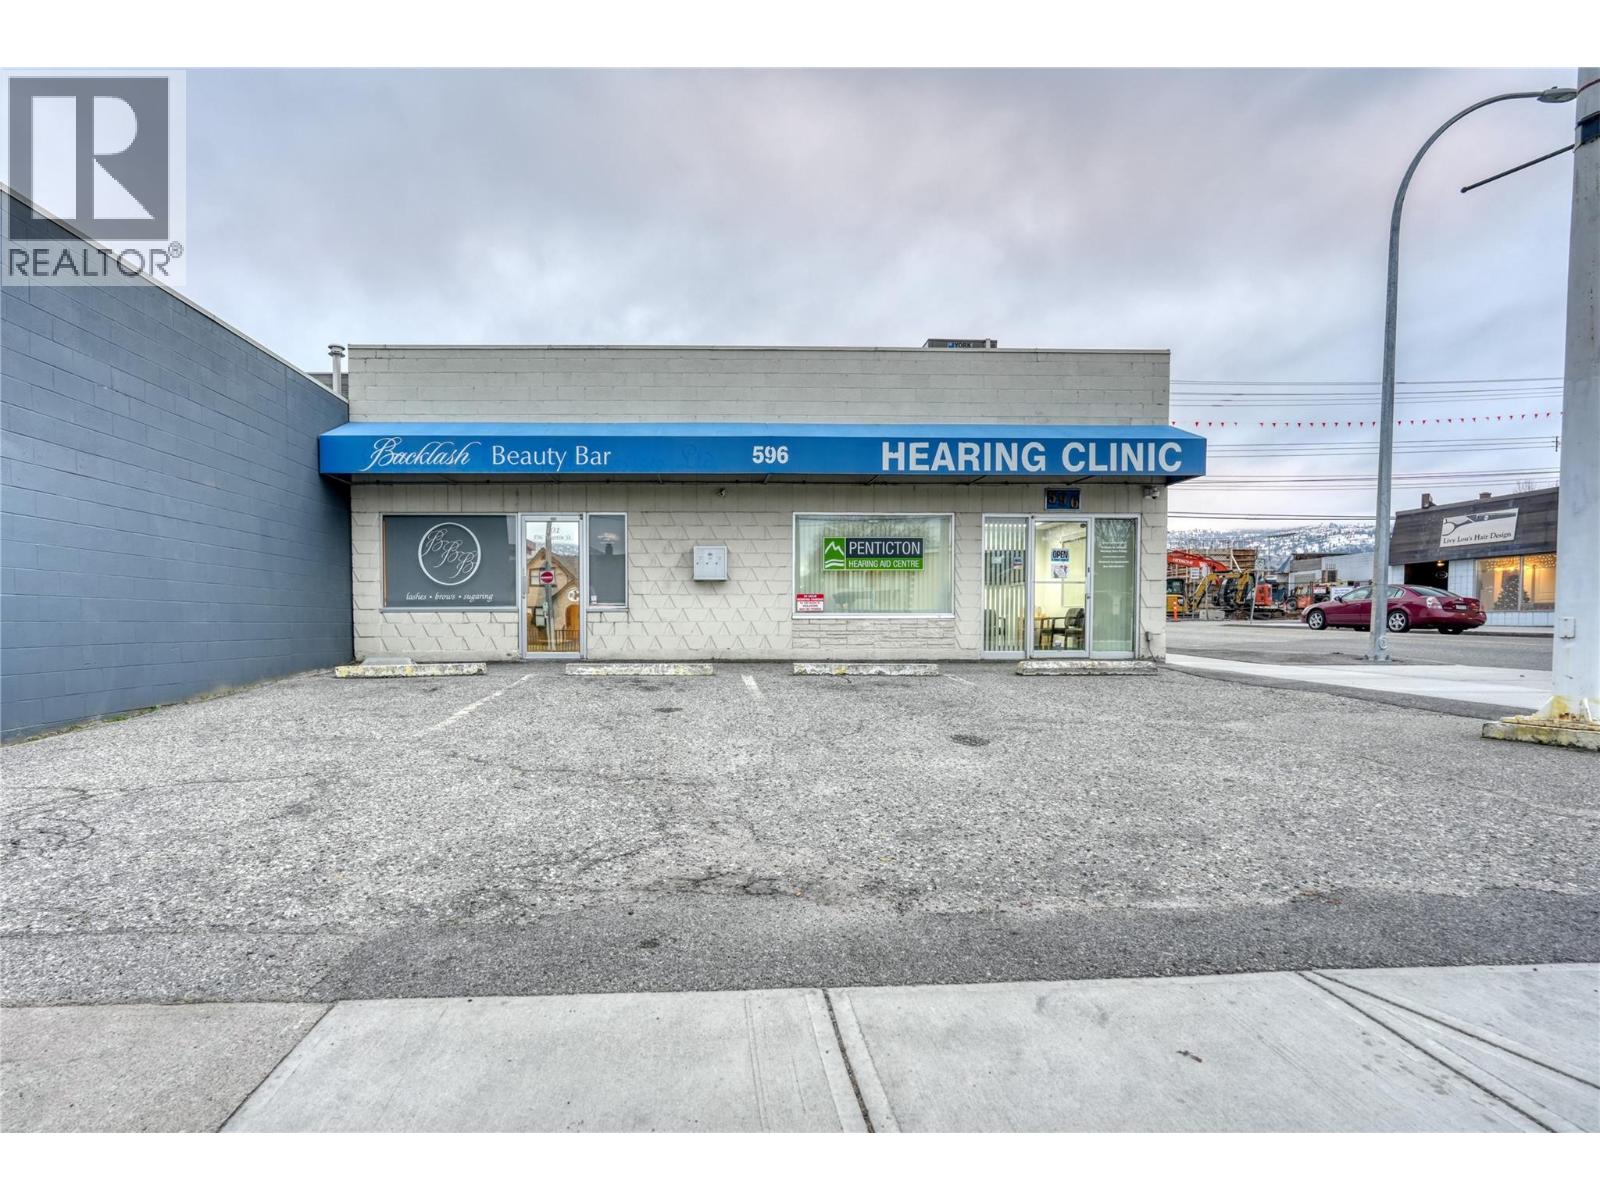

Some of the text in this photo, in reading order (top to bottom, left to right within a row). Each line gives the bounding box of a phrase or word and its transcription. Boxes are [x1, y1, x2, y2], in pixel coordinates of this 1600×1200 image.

[360, 436, 611, 472] Backlash Beauty Bar
[752, 445, 789, 464] 596
[882, 441, 1182, 472] HEARING CLINIC
[1474, 533, 1489, 541] Hair
[1490, 531, 1512, 539] Design
[849, 541, 920, 555] PENTICTON
[1052, 550, 1069, 559] OPEN
[848, 560, 919, 568] HEARING AID CENTRE
[406, 592, 494, 602] lashes brows sugaring
